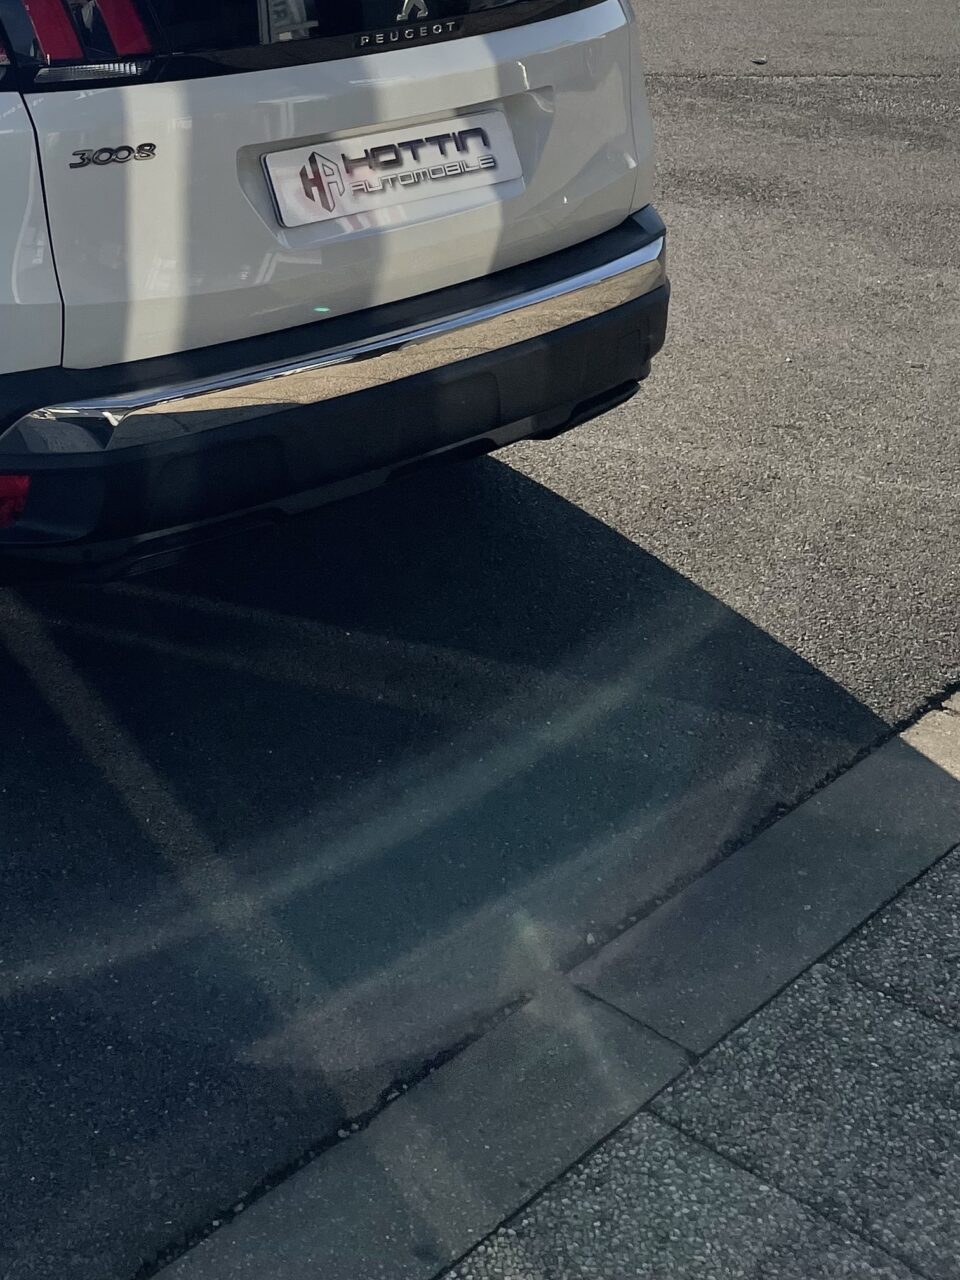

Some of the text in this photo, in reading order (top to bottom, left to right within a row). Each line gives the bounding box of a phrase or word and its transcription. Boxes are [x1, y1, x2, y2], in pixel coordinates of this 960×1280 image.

[360, 22, 455, 46] PEUGEOT
[69, 143, 156, 169] 3008
[341, 127, 489, 174] HOTTIN
[349, 154, 496, 196] AUTOMOBILE
